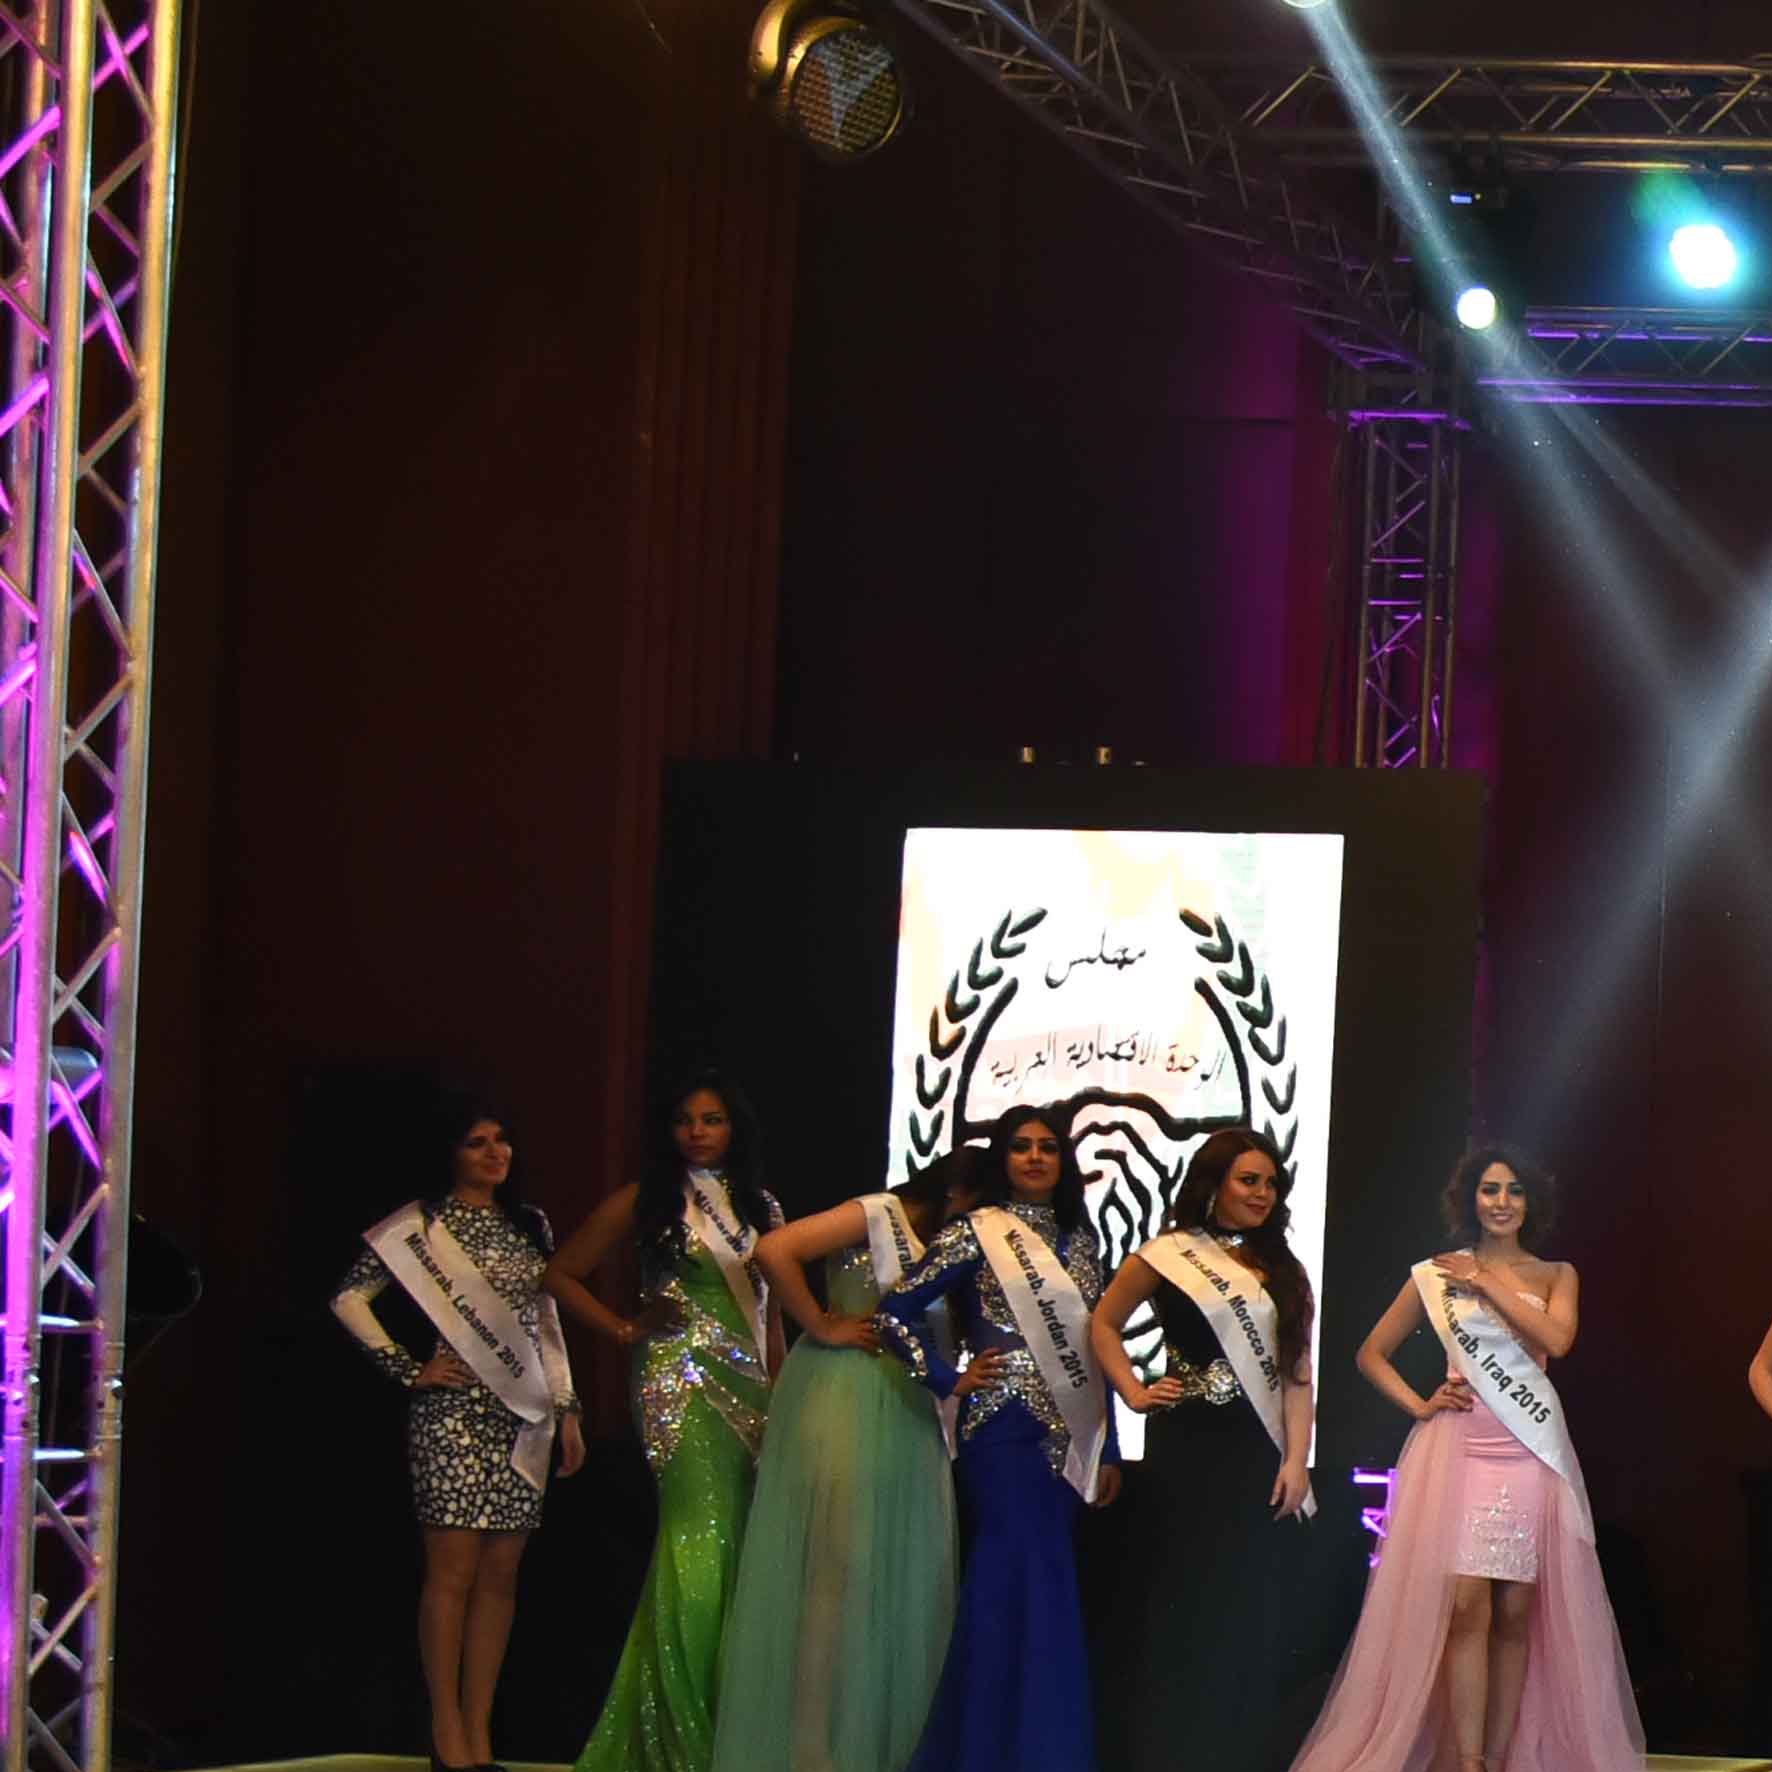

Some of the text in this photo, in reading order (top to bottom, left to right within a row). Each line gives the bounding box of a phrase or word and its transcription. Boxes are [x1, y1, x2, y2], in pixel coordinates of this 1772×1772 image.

[496, 1345, 526, 1379] 2015
[1037, 1299, 1069, 1350] Jordan
[1059, 1350, 1089, 1389] 2015
[1227, 1294, 1265, 1357] Morocco
[1259, 1355, 1281, 1393] 2015
[1480, 1353, 1513, 1393] Iraq
[1510, 1384, 1551, 1424] 2015
